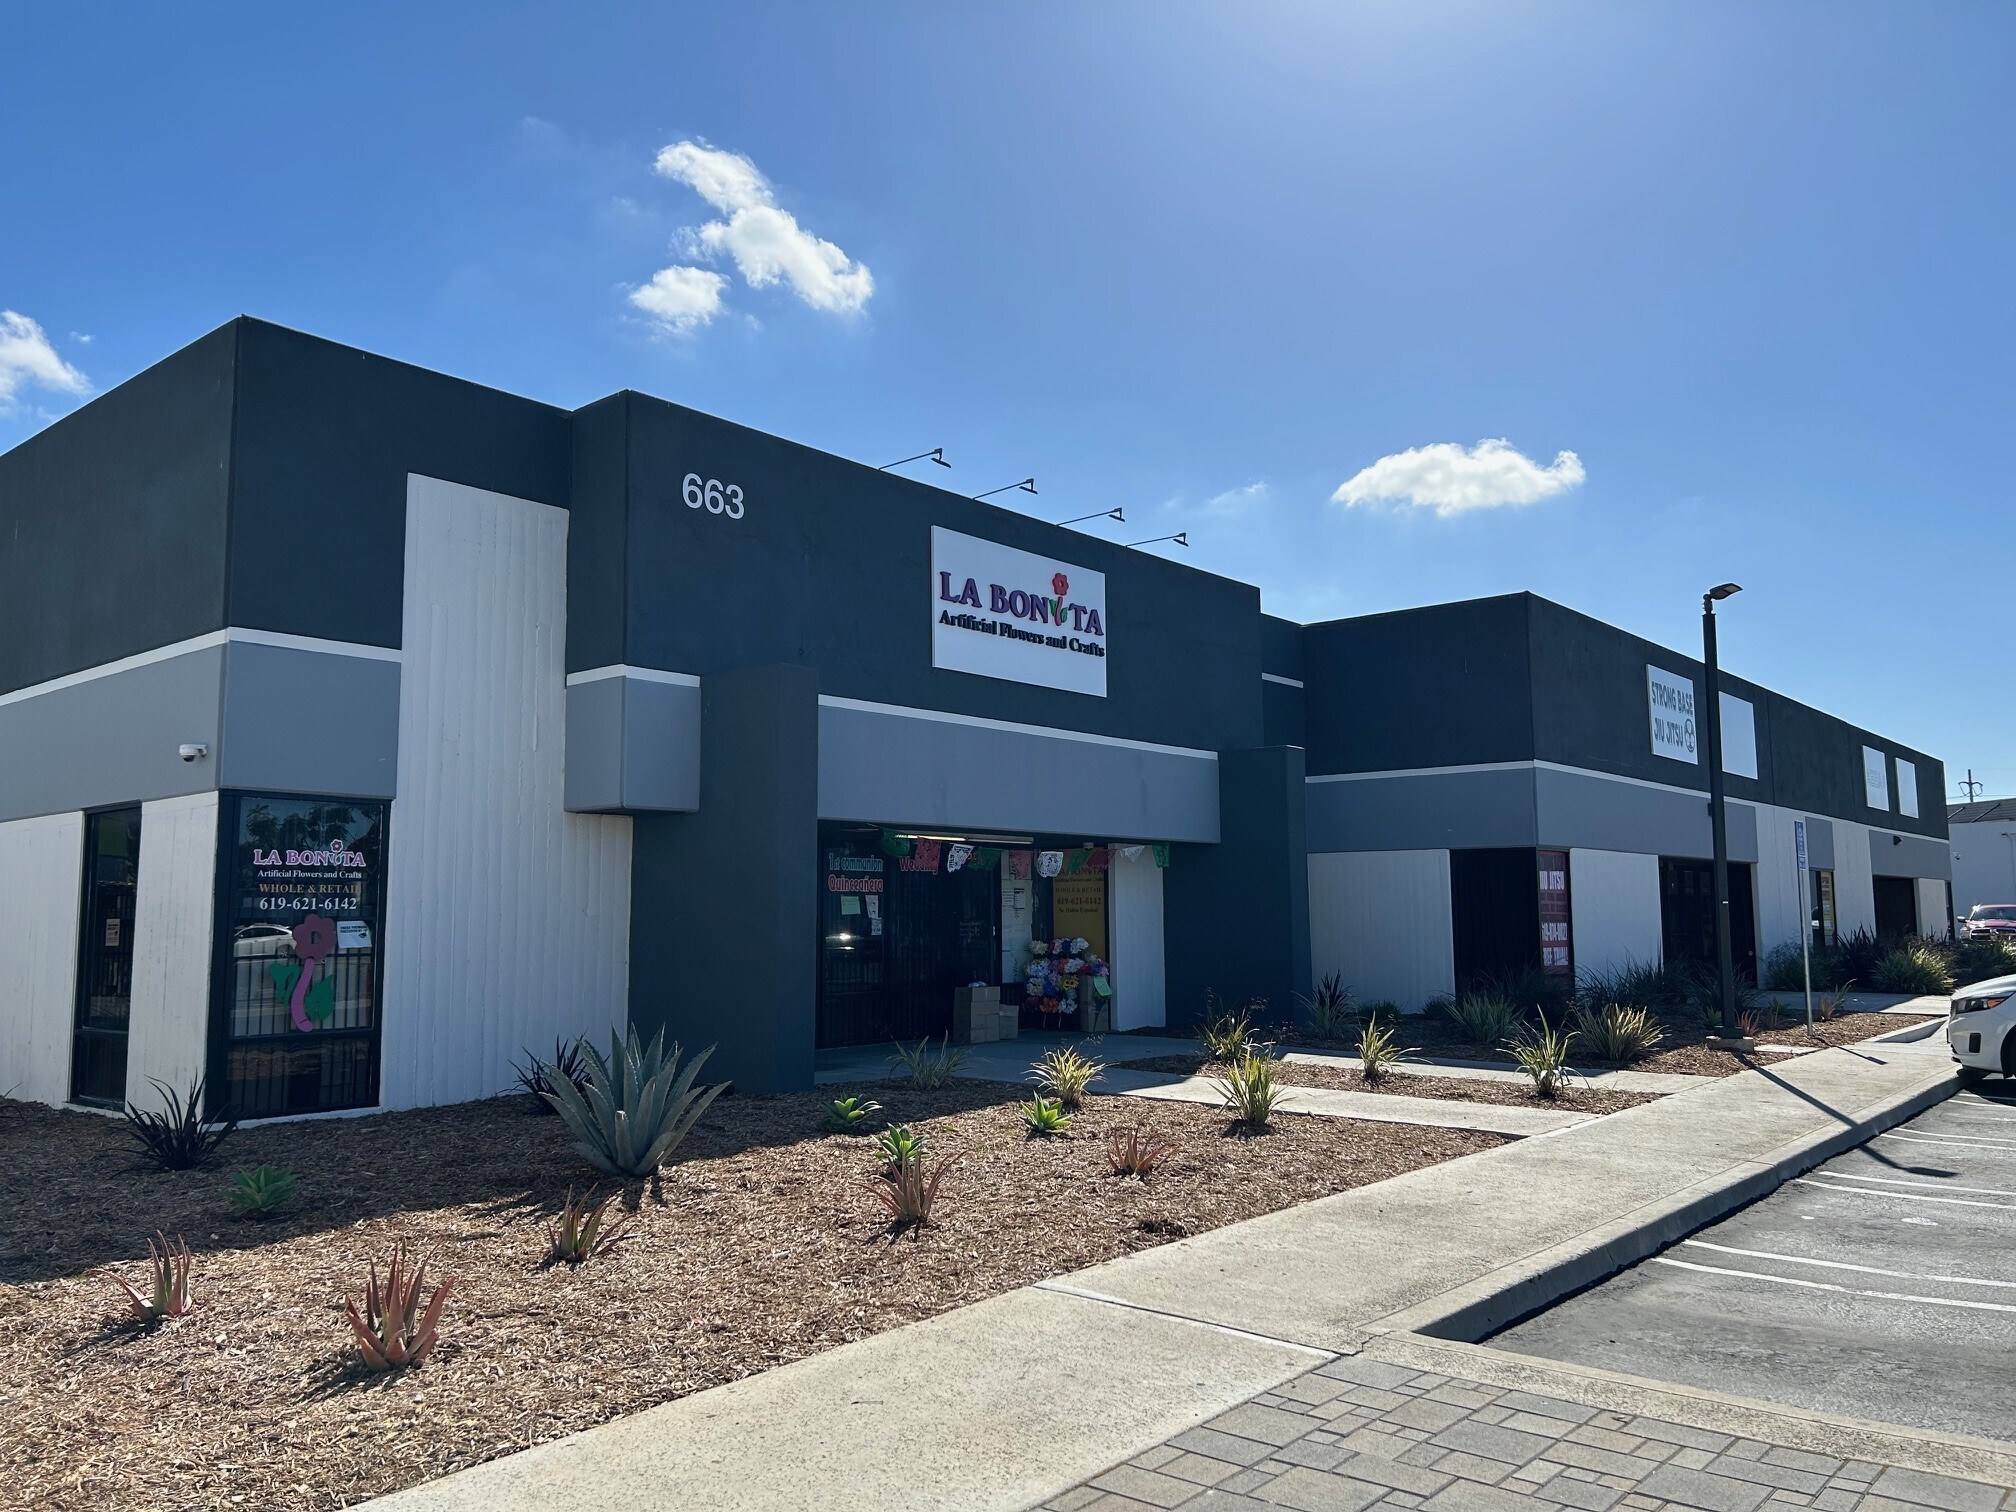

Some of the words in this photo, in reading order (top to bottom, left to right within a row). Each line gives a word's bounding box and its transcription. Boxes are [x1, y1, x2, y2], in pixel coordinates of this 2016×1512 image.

[682, 473, 745, 520] 663
[940, 571, 982, 608] LA
[990, 573, 1104, 636] BONITA
[939, 609, 997, 635] Artificial
[999, 622, 1044, 645] Flowers
[1046, 635, 1067, 649] and
[1069, 637, 1105, 657] Crafts
[1652, 681, 1676, 711] STRONG
[1678, 689, 1694, 717] BASE
[1654, 717, 1665, 742] JIU
[1666, 721, 1684, 747] JITSU
[253, 849, 282, 866] LA
[286, 843, 366, 866] BONITA
[829, 853, 840, 871] 1st
[841, 855, 883, 872] communion
[258, 870, 292, 878] Artificial
[293, 870, 322, 878] Flowers
[339, 871, 362, 879] Crafts
[259, 884, 304, 893] WHOLE
[307, 884, 316, 893] &
[260, 897, 357, 910] 619-621-6142
